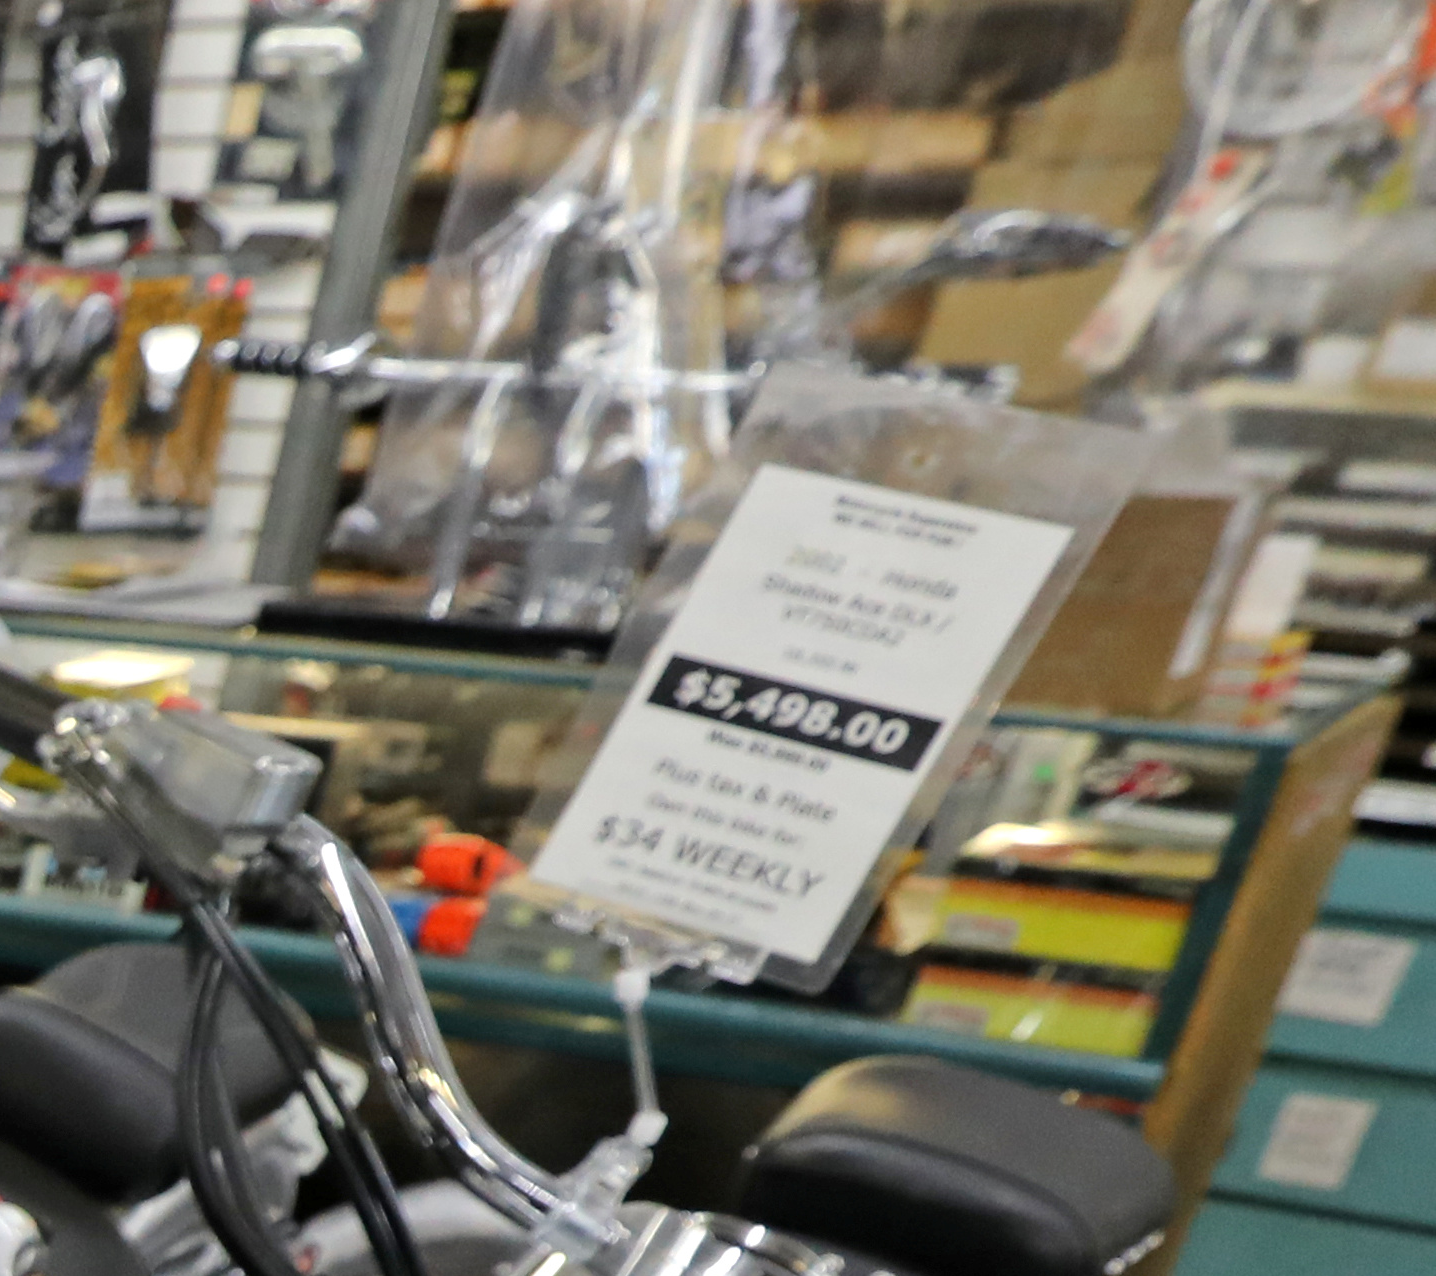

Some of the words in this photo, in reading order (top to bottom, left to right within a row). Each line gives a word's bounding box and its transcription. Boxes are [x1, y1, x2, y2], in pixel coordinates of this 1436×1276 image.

[673, 667, 910, 756] $5,498.00
[654, 756, 701, 786] Plus
[708, 773, 744, 796] tax
[752, 782, 771, 804] &
[776, 791, 837, 823] Plate
[594, 814, 665, 852] $34
[674, 834, 825, 897] WEEKLY
